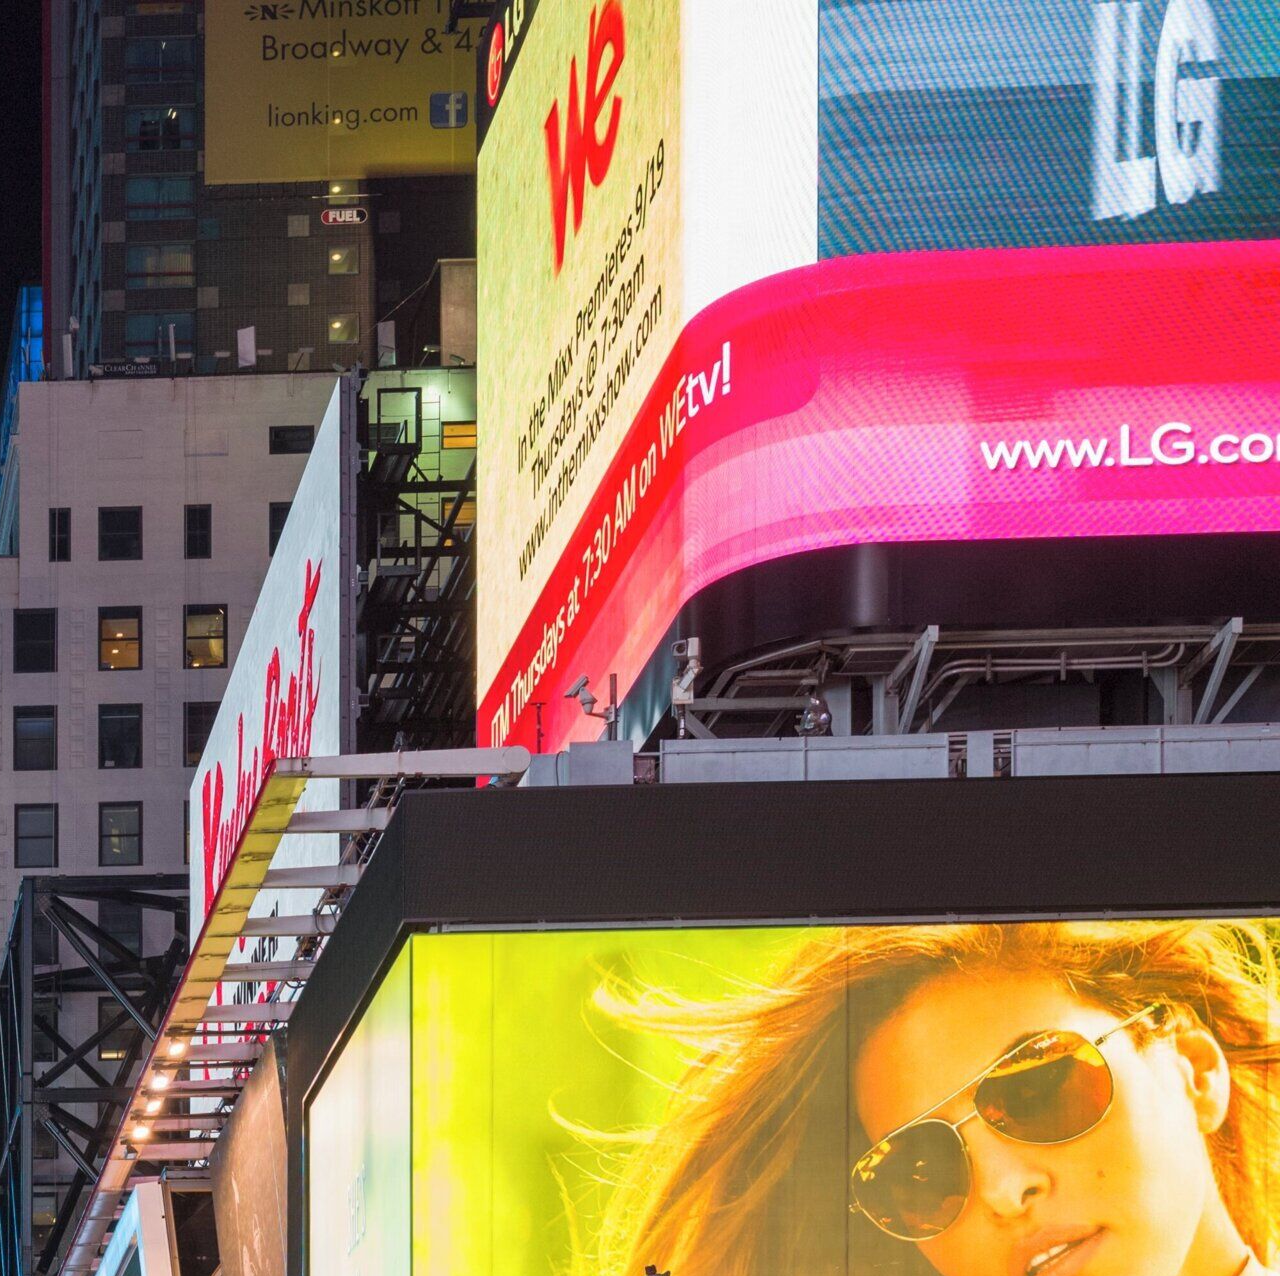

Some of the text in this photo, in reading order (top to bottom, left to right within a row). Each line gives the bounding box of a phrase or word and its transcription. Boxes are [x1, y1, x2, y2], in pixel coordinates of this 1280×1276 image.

[262, 28, 443, 64] Broadway &
[267, 102, 419, 130] lionking.com
[1090, 0, 1224, 220] LG
[328, 209, 362, 224] FUEL
[517, 138, 666, 475] In the Mixx Premieres 9/19
[518, 283, 663, 583] www.inthemixxshow.com
[531, 253, 646, 502] Thursdays @ 7:30am
[511, 604, 566, 727] Thursdays
[567, 574, 581, 623] at
[582, 512, 611, 598] 7:30
[613, 466, 636, 548] AM
[638, 441, 657, 499] on
[659, 341, 732, 460] WEtv!
